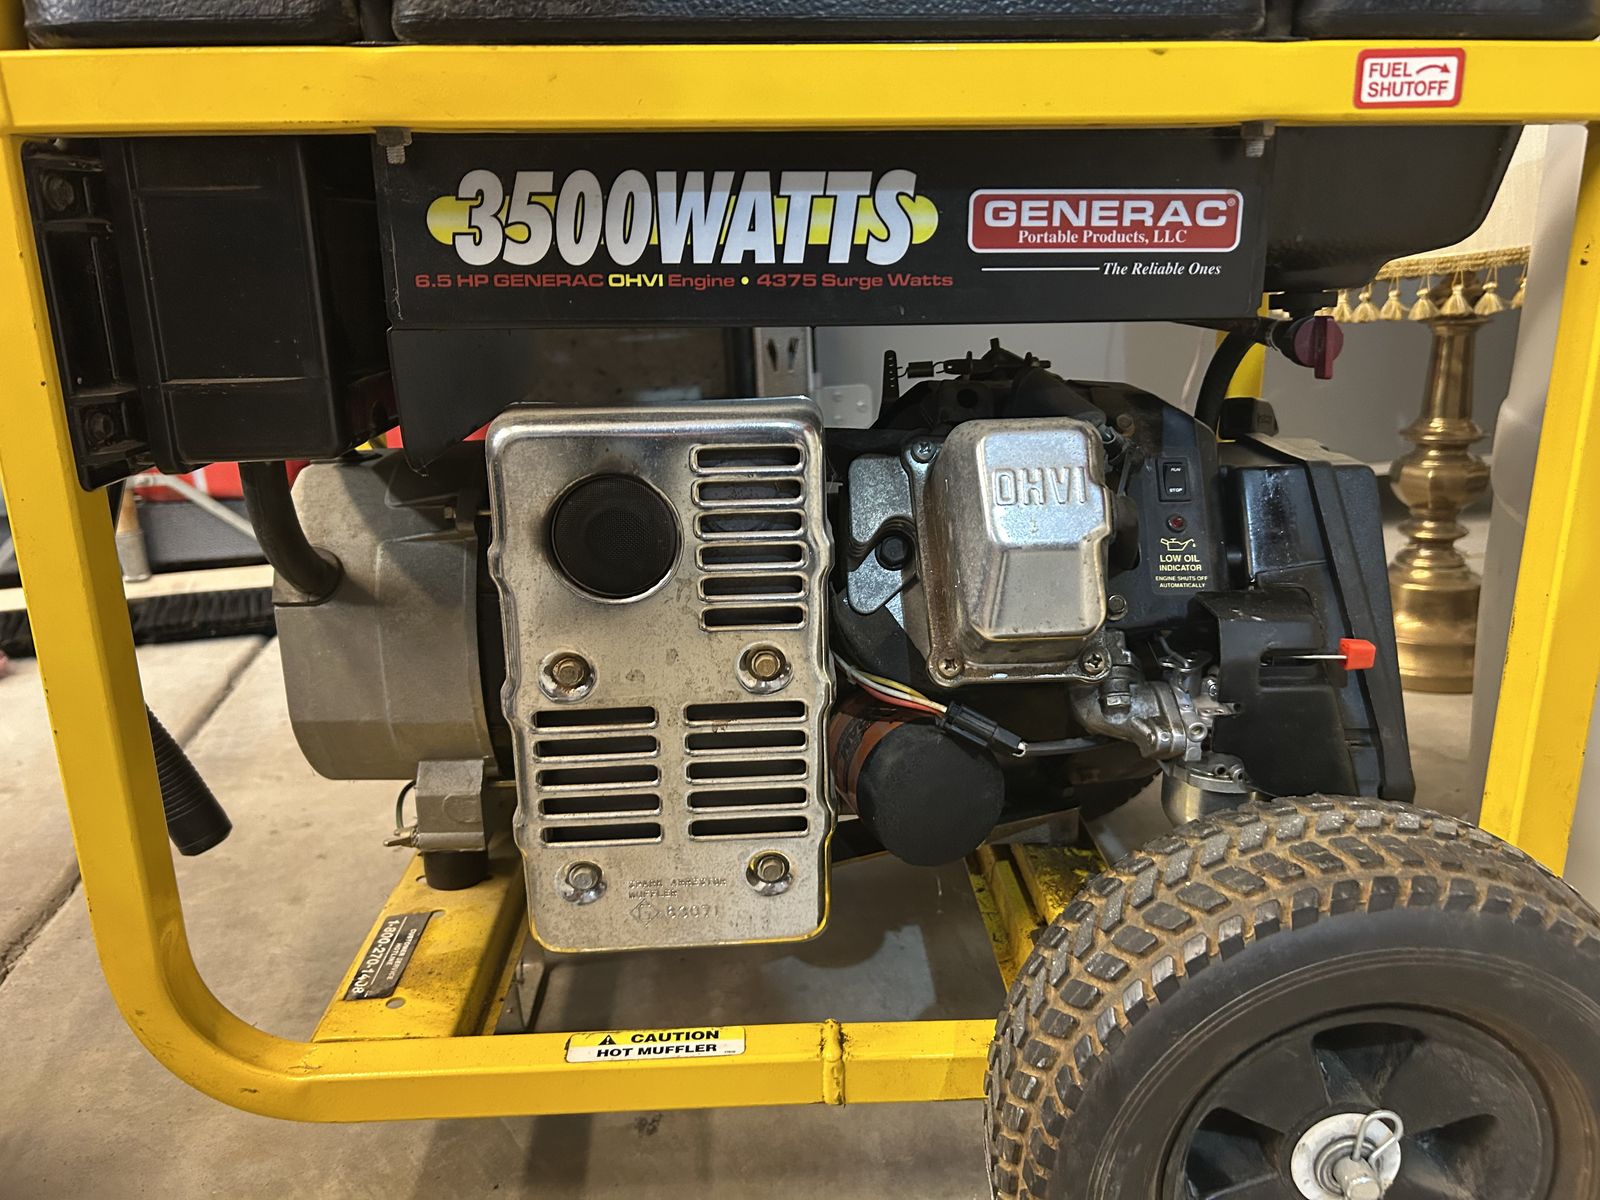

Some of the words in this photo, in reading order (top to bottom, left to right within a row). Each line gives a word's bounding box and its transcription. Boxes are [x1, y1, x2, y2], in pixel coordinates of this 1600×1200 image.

[1369, 62, 1412, 78] FUEL
[1368, 80, 1449, 97] SHUTOFF
[454, 169, 917, 265] 3500WATTS
[1018, 230, 1078, 244] Portable
[1082, 229, 1149, 245] Products,
[1153, 229, 1187, 243] LLC
[1103, 262, 1130, 275] The
[1131, 262, 1185, 275] Reliable
[1188, 262, 1221, 275] Ones
[415, 274, 451, 288] 6.5
[457, 274, 489, 288] HP
[493, 274, 604, 288] GENERAC
[608, 273, 664, 288] OHVI
[668, 274, 735, 290] Engine
[756, 274, 817, 287] 4375
[821, 274, 883, 290] Surge
[888, 273, 954, 287] Watts
[992, 466, 1087, 506] OHVI
[1160, 554, 1182, 562] LOW
[1184, 554, 1200, 562] OIL
[1159, 564, 1202, 572] INDICATOR
[631, 1030, 720, 1044] CAUTION
[596, 1047, 633, 1058] HOT
[637, 1043, 717, 1056] MUFFLER
